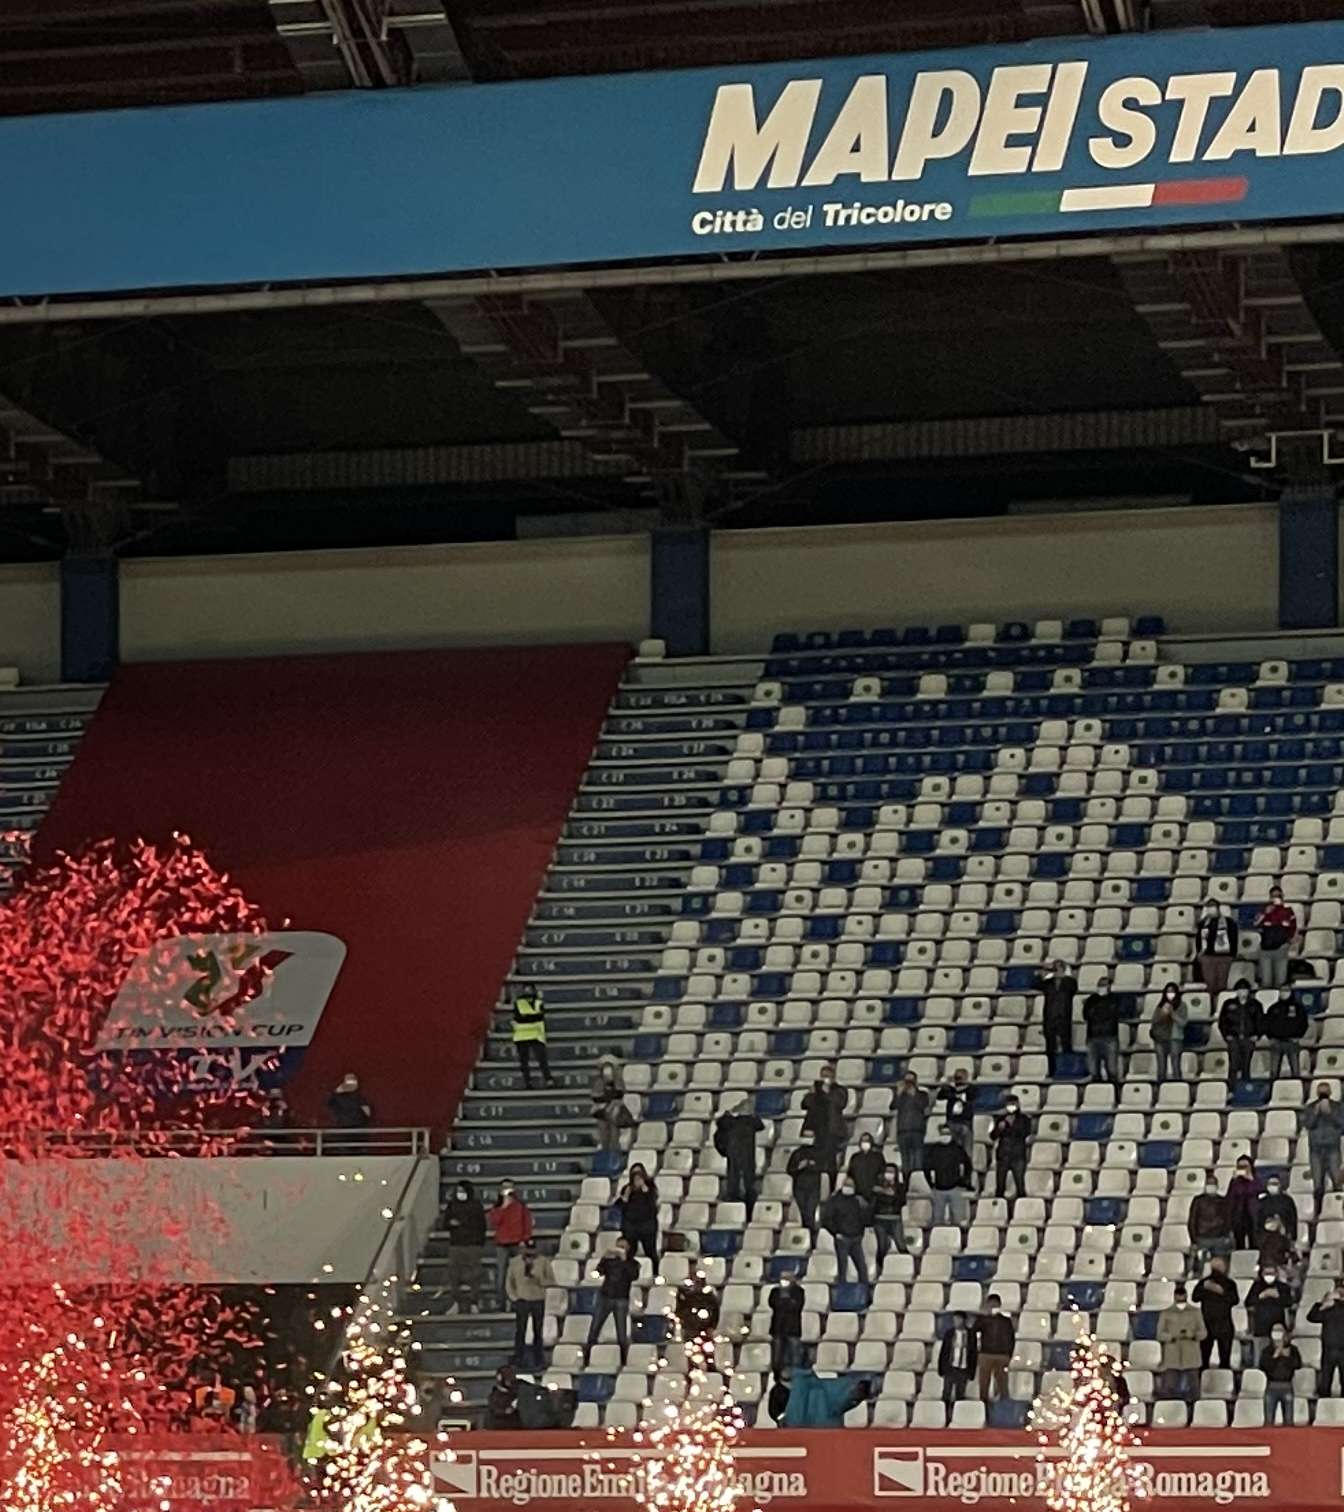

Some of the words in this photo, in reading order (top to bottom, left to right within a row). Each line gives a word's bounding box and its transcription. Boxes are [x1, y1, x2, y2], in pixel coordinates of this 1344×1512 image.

[692, 61, 1088, 193] MAPEI
[692, 208, 764, 236] Città
[773, 203, 813, 231] del
[822, 198, 953, 228] Tricolore
[251, 1024, 304, 1037] CUP
